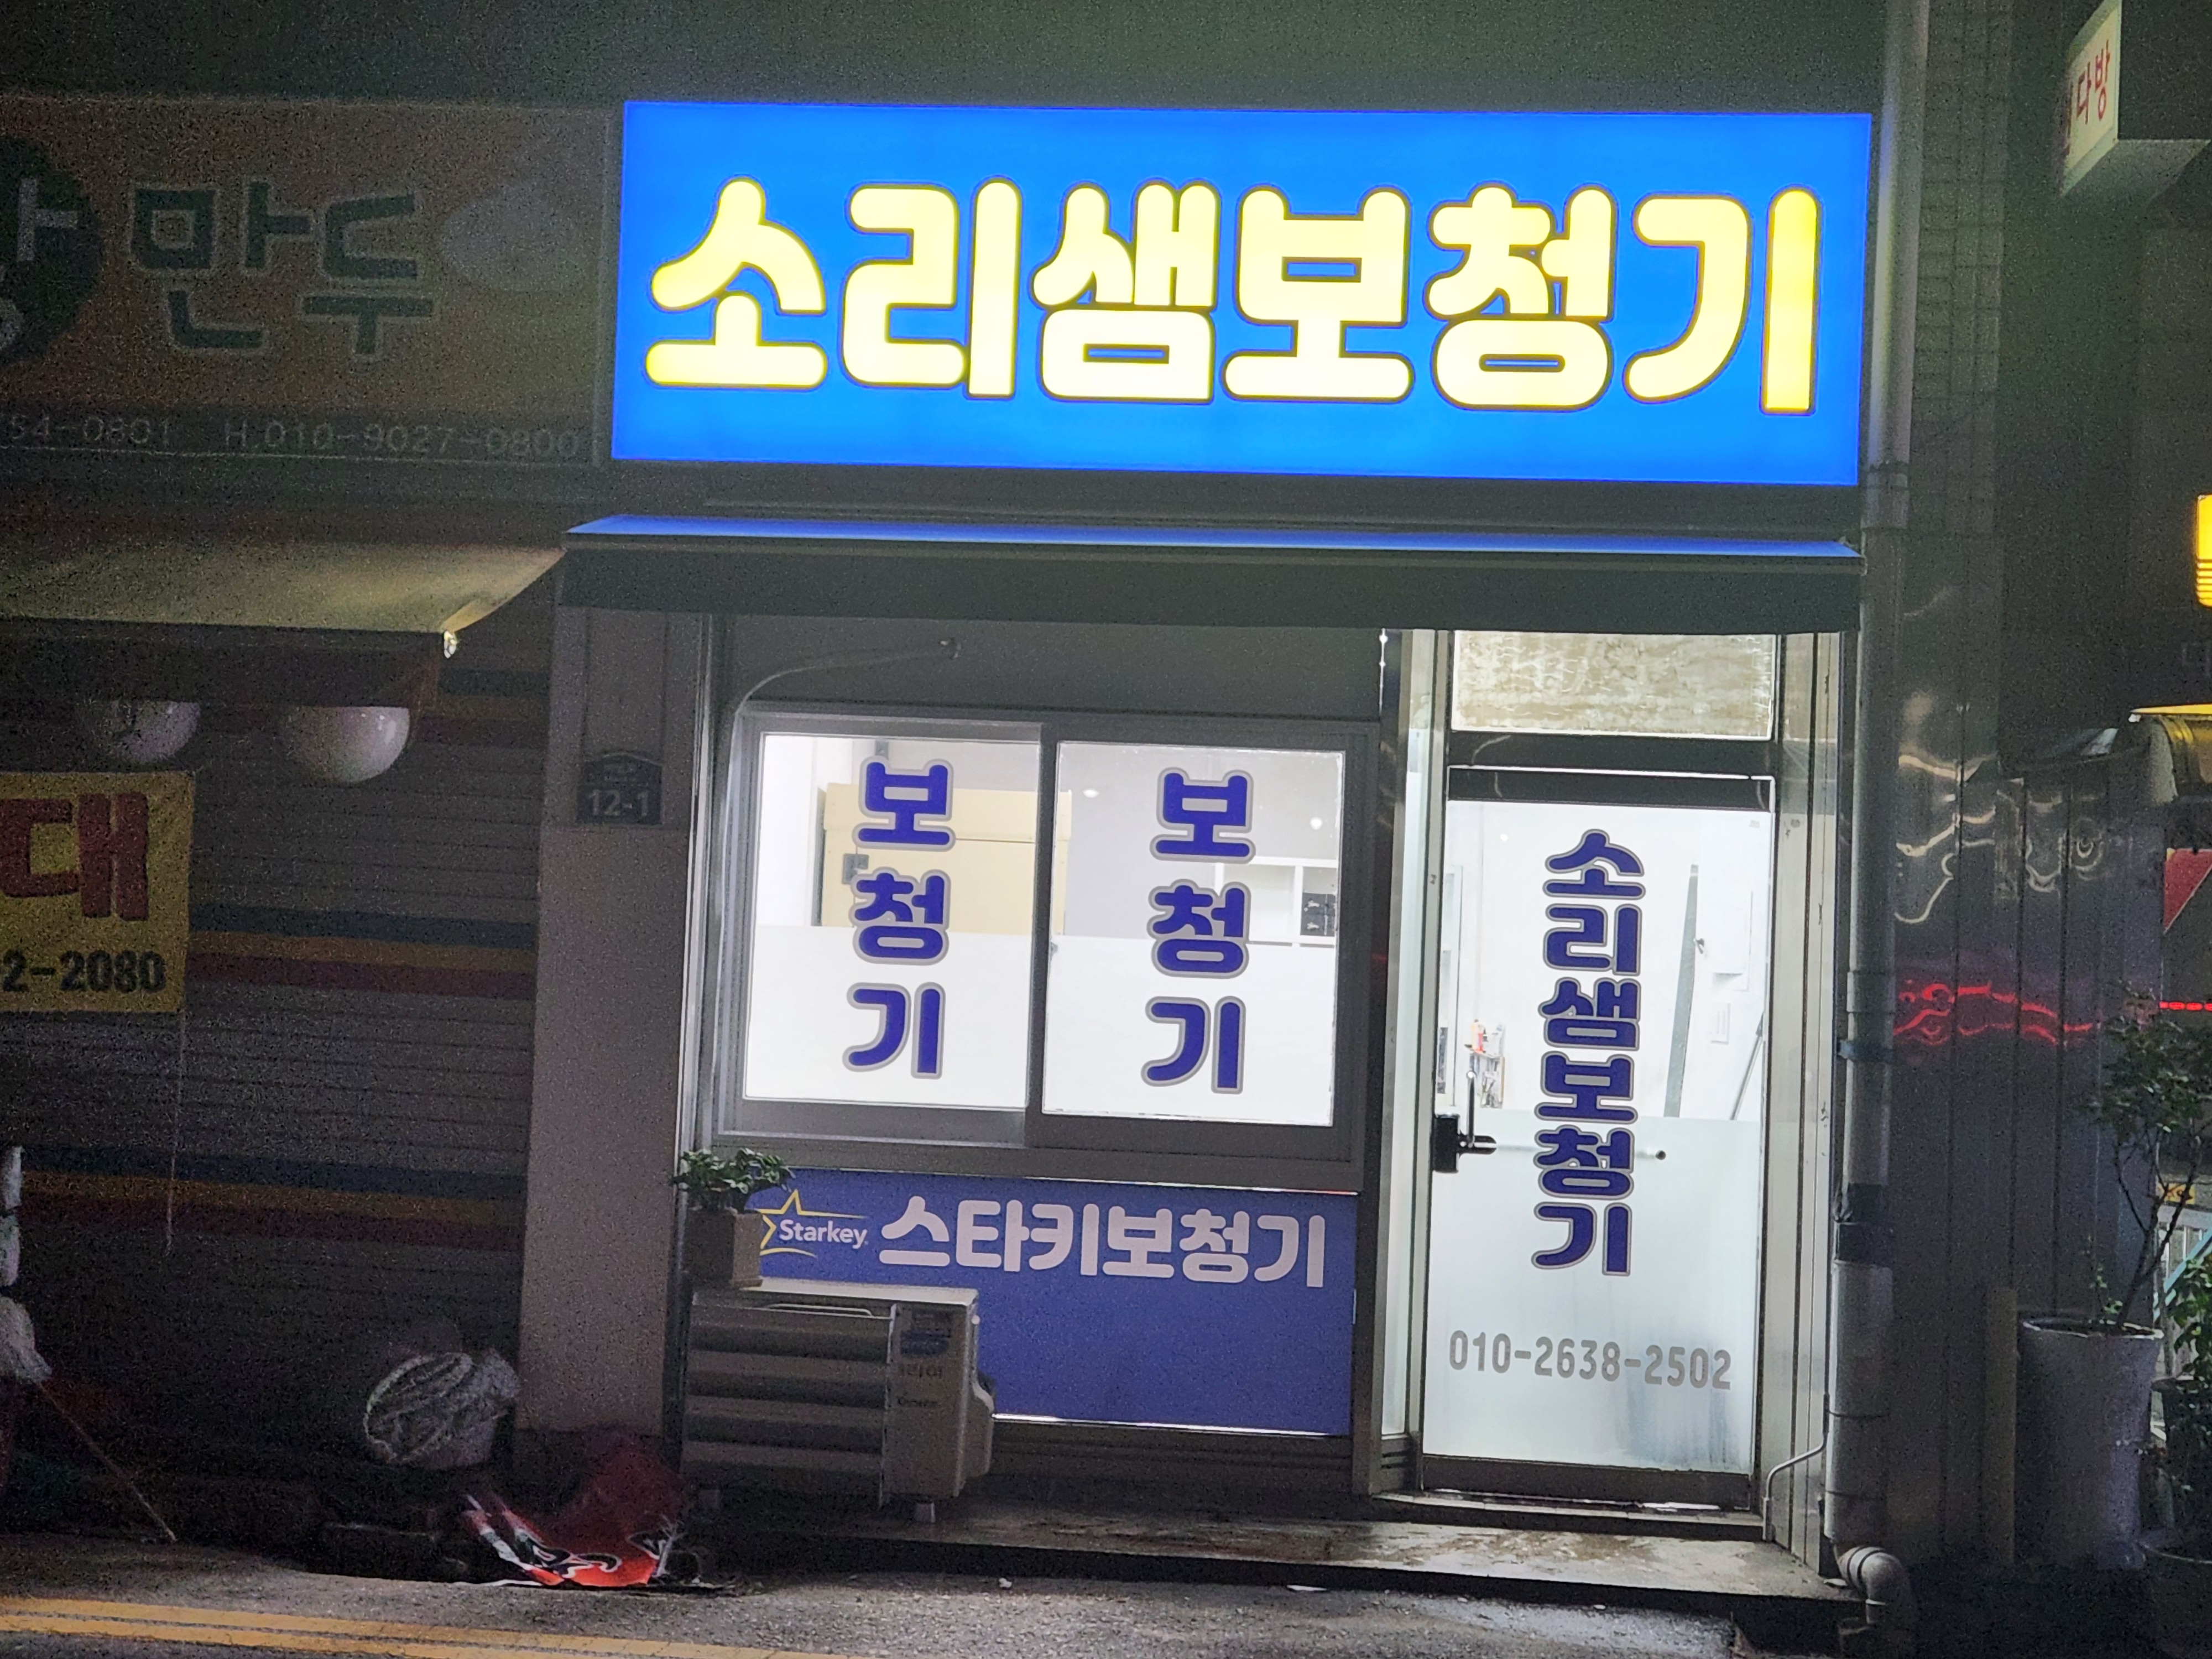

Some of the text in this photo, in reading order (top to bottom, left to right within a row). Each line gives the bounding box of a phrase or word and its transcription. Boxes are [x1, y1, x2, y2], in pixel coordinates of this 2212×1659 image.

[133, 181, 435, 356] 만두
[644, 177, 1818, 413] 소리샘보청기
[0, 793, 148, 921] 대
[586, 788, 649, 817] 12-1
[846, 758, 954, 1077] 보청기
[1143, 770, 1254, 1092] 보청기
[1532, 829, 1645, 1276] 소리샘보청기
[779, 1219, 868, 1249] Starkey
[879, 1196, 1325, 1288] 스타키보청기
[1448, 1330, 1732, 1390] 010-2638-2502
